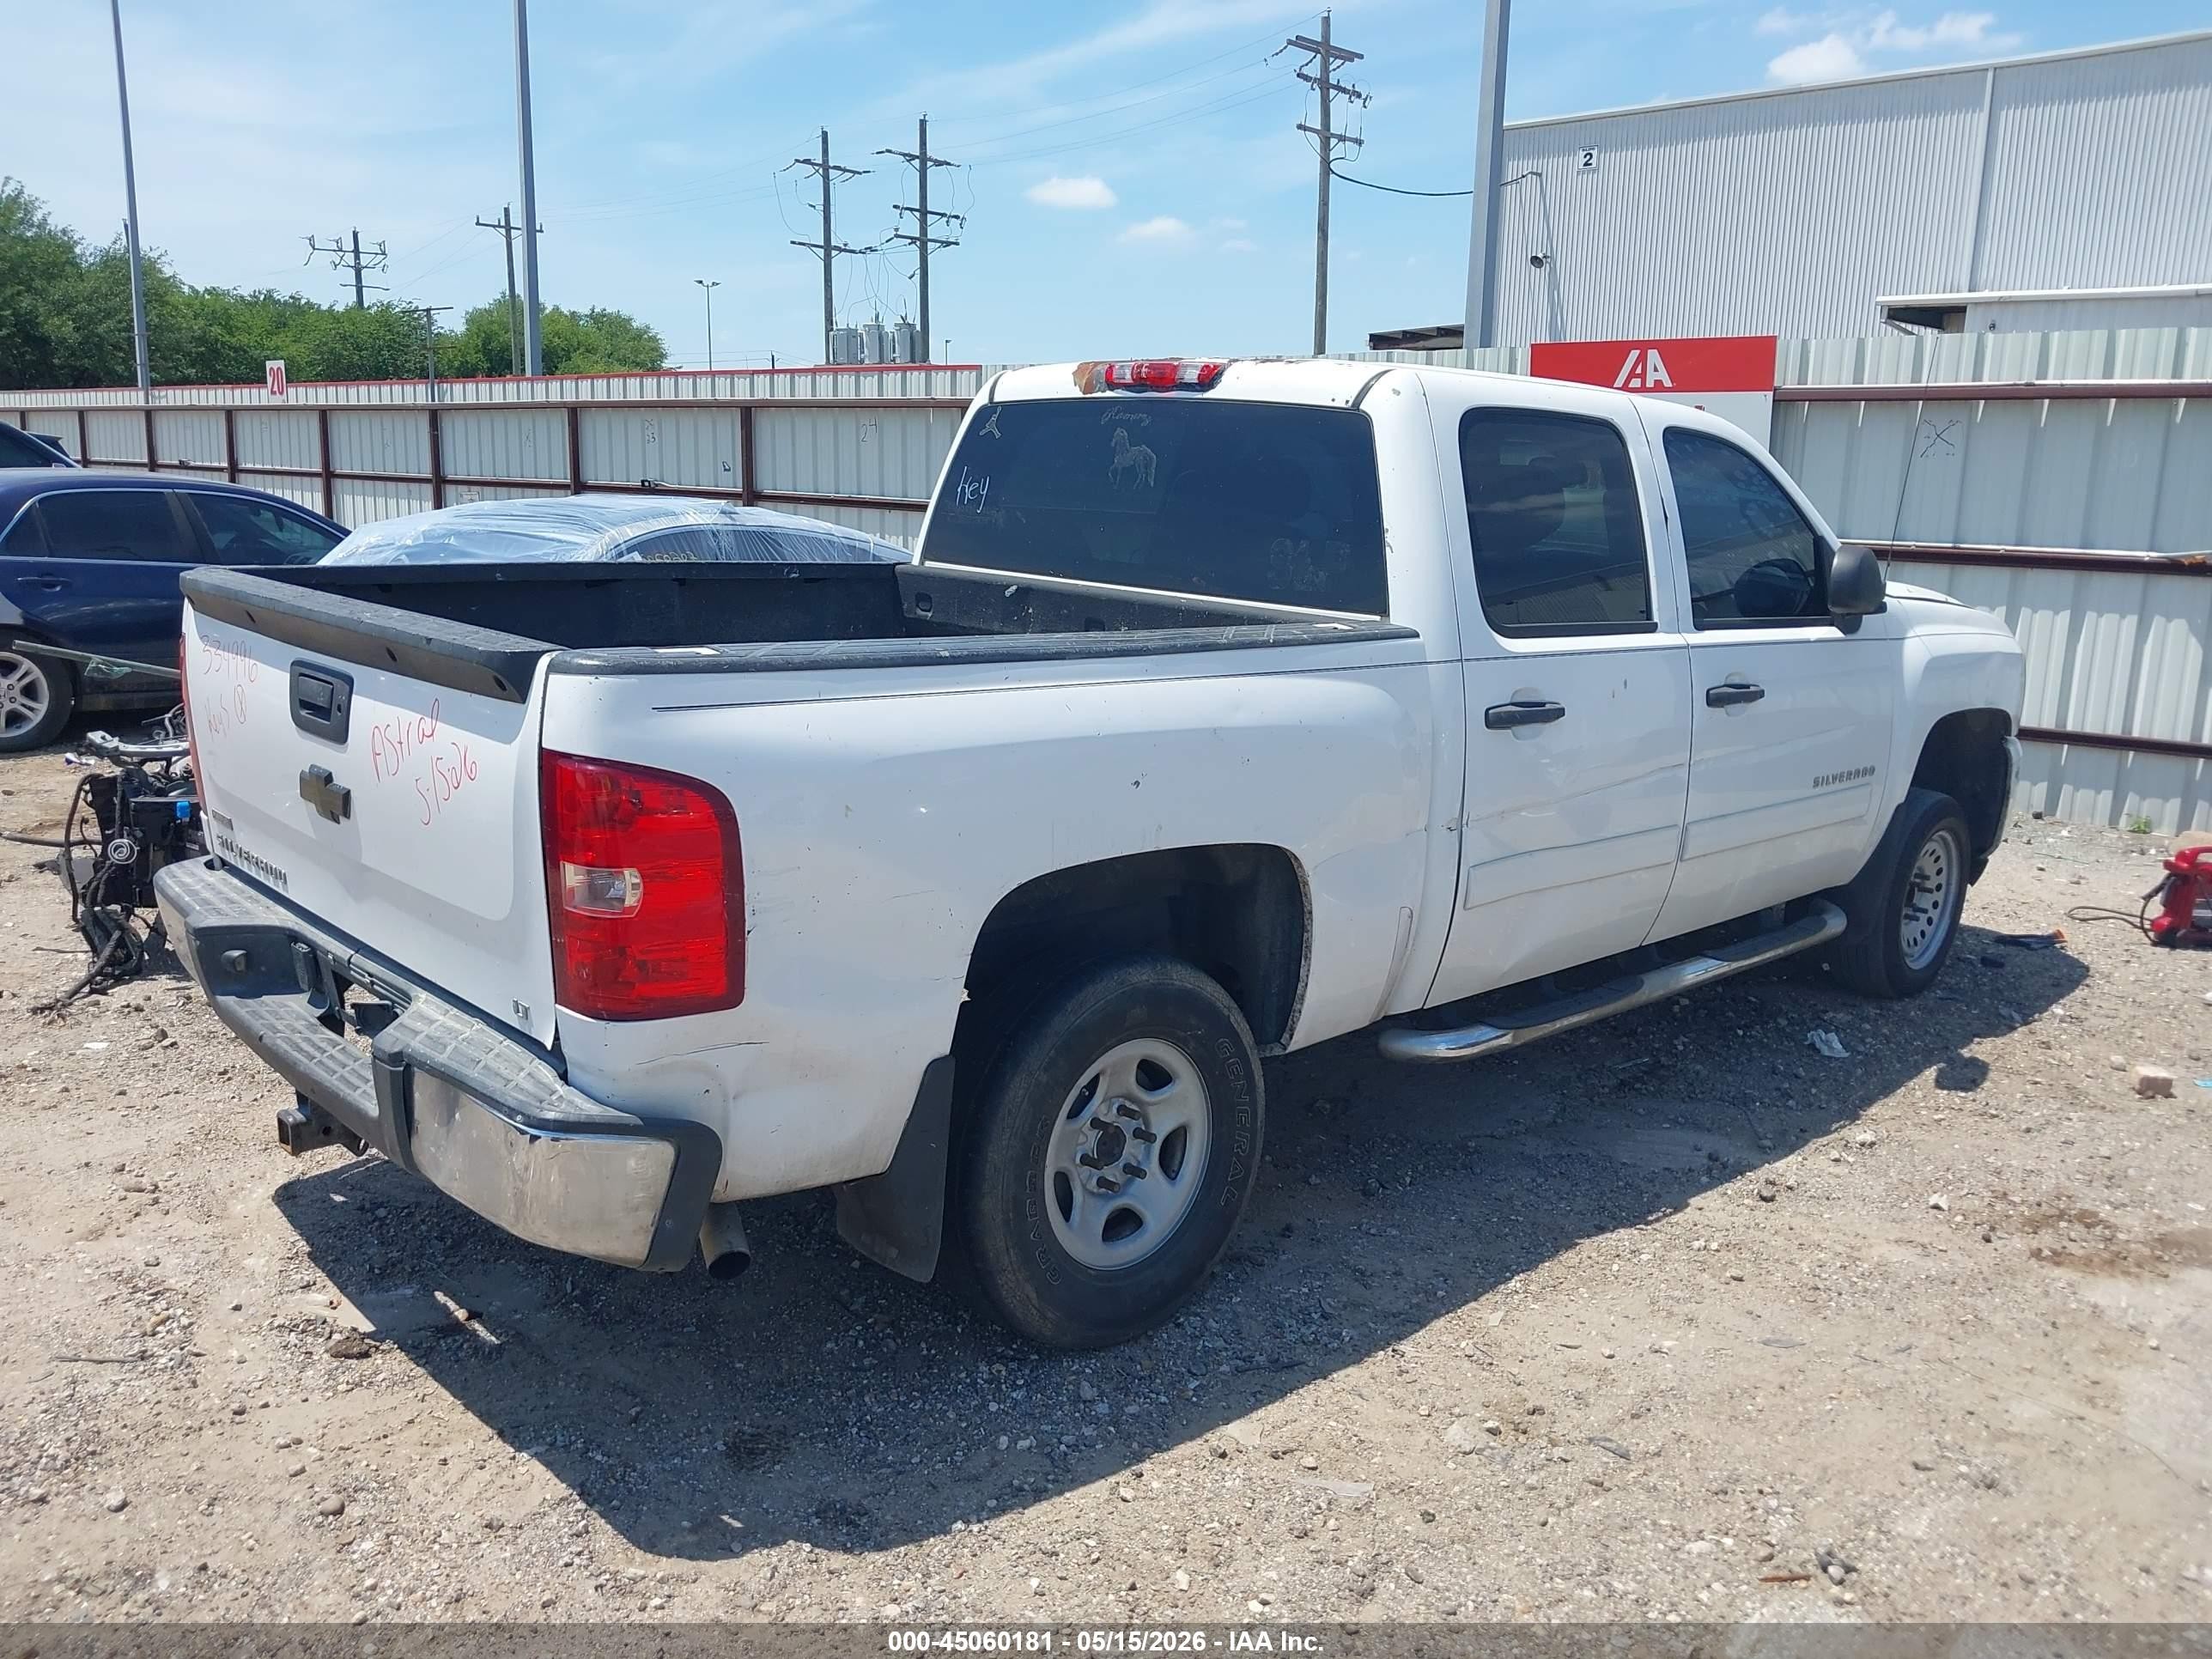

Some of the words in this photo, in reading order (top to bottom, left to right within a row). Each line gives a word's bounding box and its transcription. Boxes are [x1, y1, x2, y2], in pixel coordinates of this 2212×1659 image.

[1583, 151, 1594, 167] 2
[268, 366, 285, 396] 20
[860, 416, 878, 443] 24
[1812, 764, 1876, 790] SILVERADO
[512, 998, 531, 1021] LT
[1214, 1037, 1252, 1209] GENERAL
